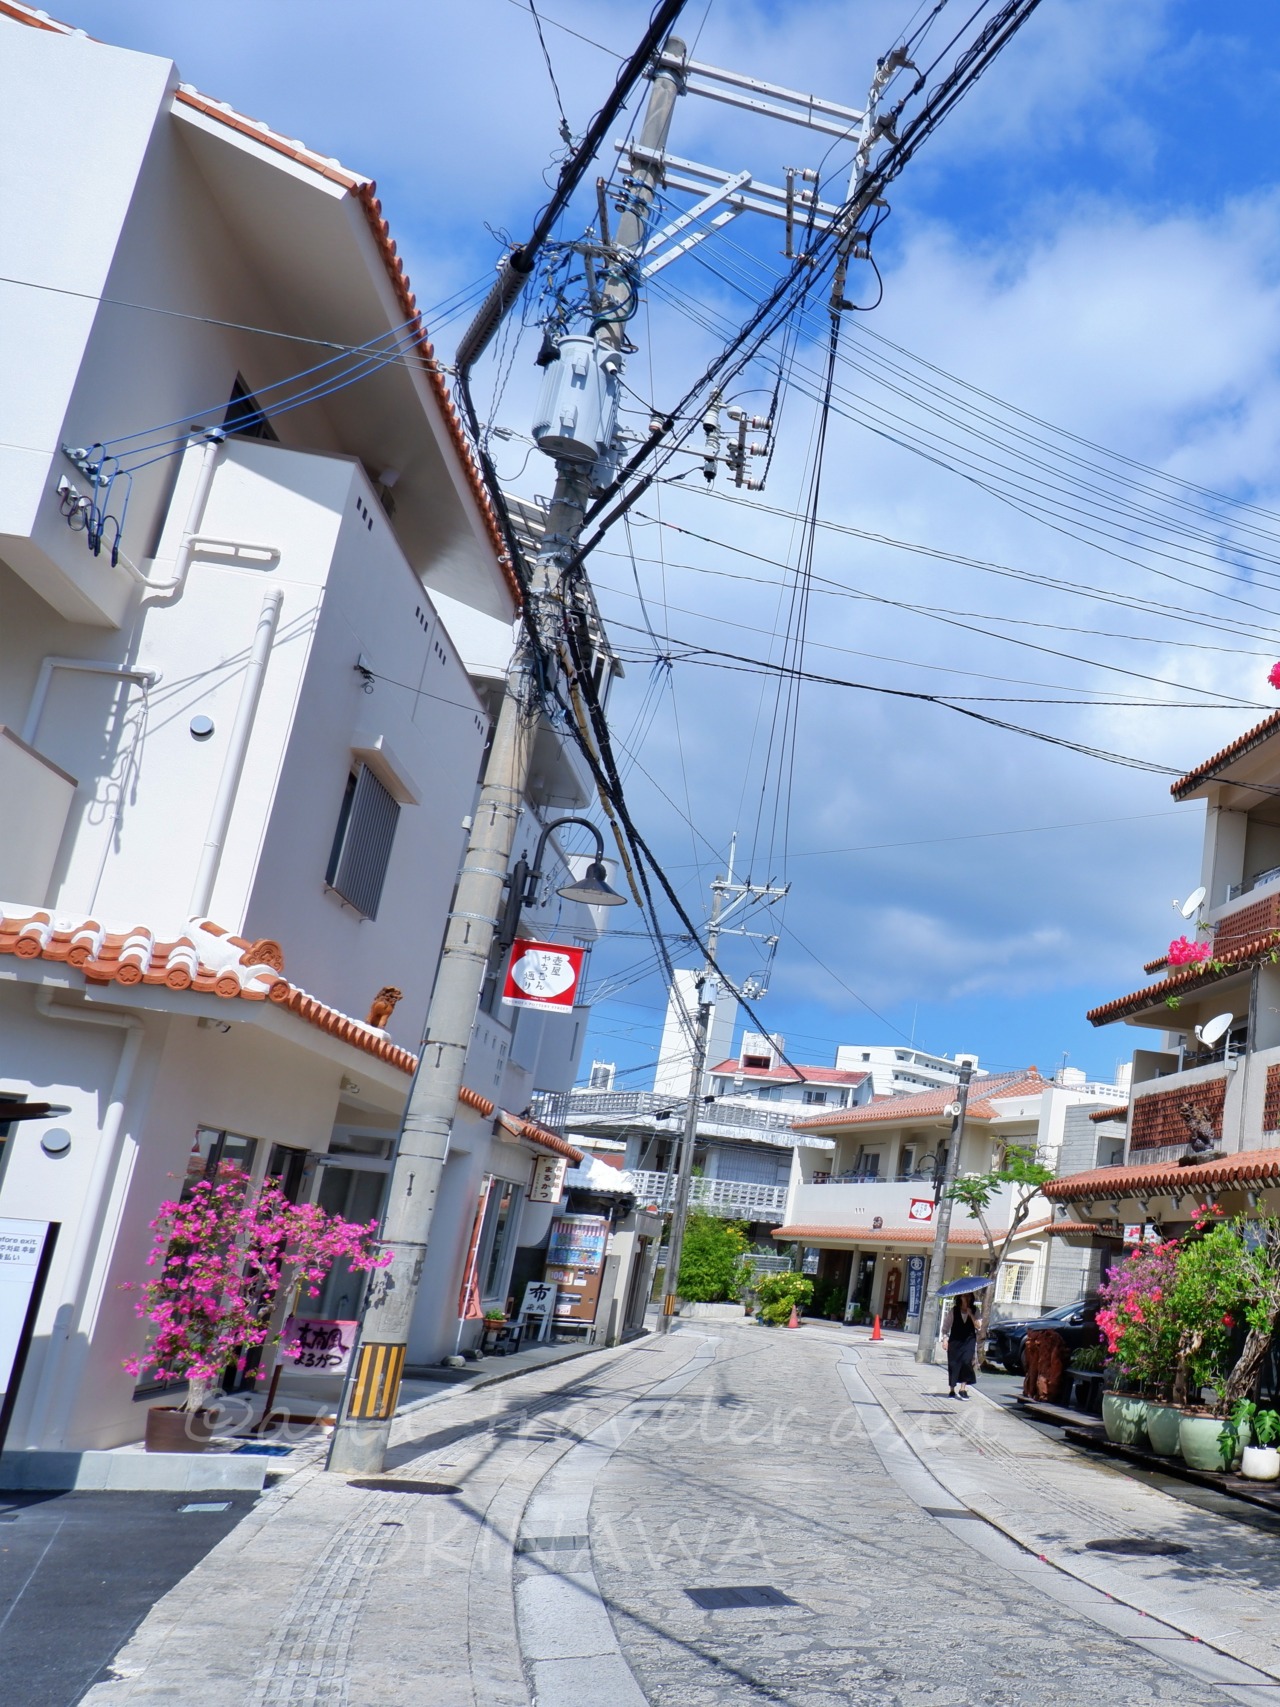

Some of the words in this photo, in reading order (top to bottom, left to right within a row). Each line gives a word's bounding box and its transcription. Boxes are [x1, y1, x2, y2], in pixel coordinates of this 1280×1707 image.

[523, 970, 536, 991] 通り
[535, 954, 551, 991] やちむん
[540, 1166, 553, 1198] まるかつ
[528, 1284, 552, 1303] 布
